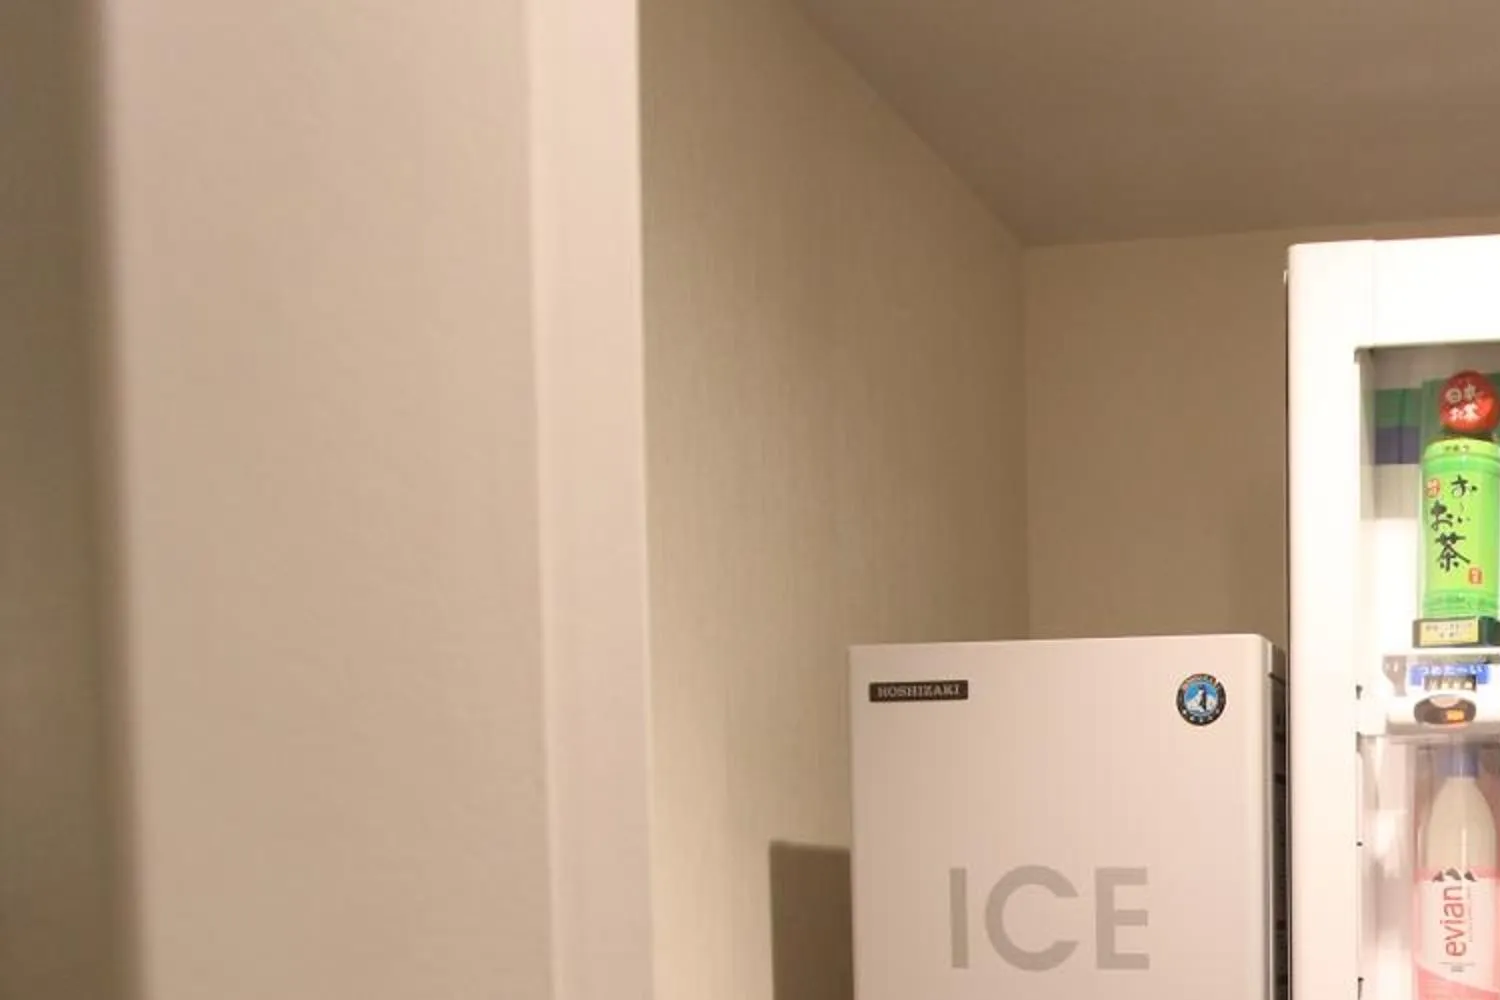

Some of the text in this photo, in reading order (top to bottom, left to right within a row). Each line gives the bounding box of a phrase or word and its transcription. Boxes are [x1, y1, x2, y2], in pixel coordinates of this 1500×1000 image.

[877, 685, 962, 699] HOSHIZAKI
[949, 865, 1150, 972] ICE
[1440, 885, 1467, 957] evian
